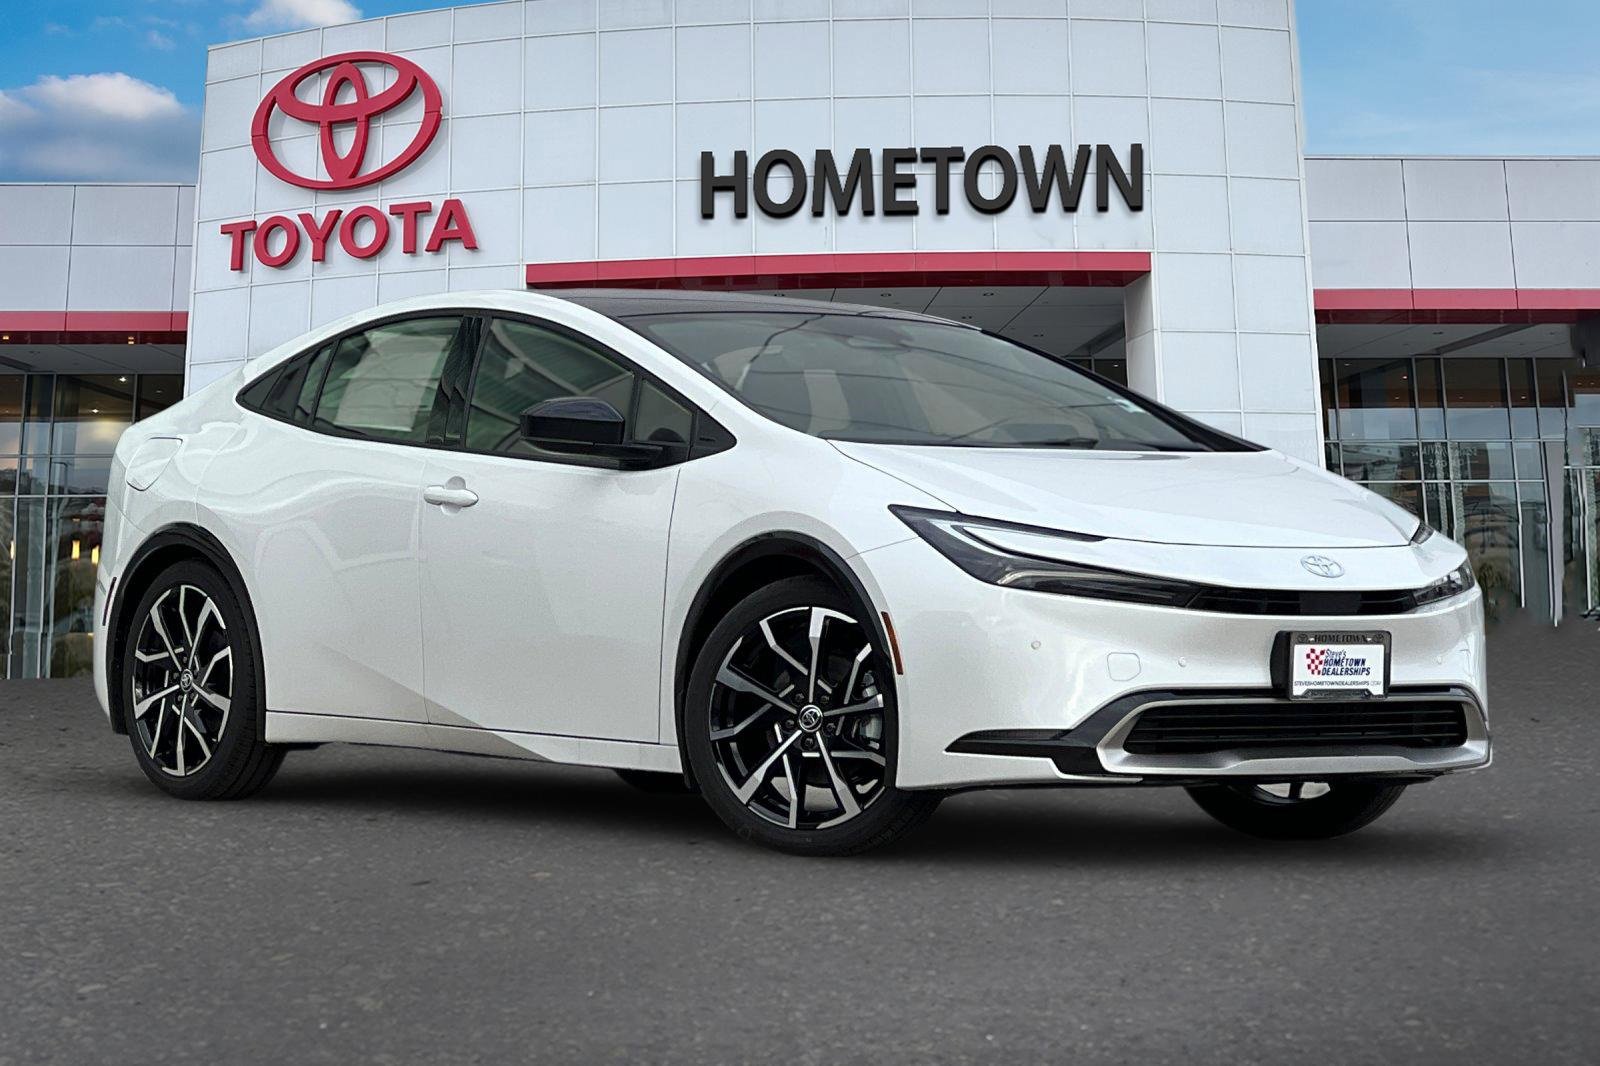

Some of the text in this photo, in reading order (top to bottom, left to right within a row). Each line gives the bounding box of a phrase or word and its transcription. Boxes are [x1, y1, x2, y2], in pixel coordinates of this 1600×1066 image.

[700, 143, 1144, 219] HOMETOWN
[220, 198, 479, 271] TOYOTA
[1314, 634, 1368, 642] HOMETOWN
[1325, 648, 1347, 659] Steve's
[1323, 658, 1367, 667] HOMETOWN
[1321, 667, 1371, 676] DEALERSHIPS
